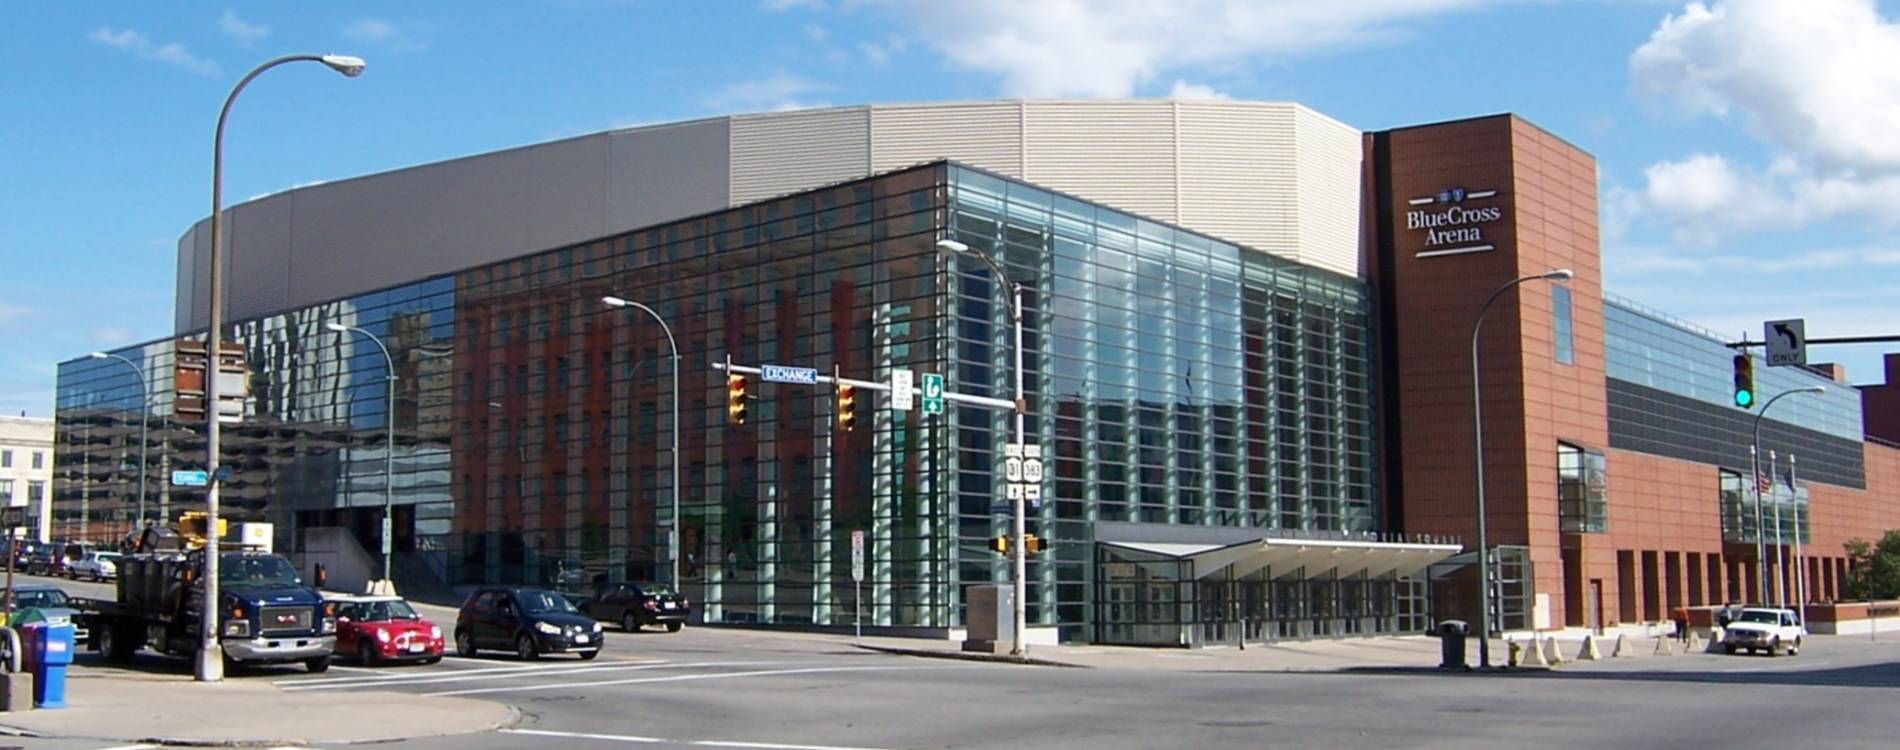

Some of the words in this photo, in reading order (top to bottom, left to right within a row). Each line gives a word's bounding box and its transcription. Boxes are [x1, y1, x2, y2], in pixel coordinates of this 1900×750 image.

[1407, 207, 1502, 229] BlueCross
[1425, 227, 1481, 246] Arena
[1773, 352, 1799, 362] ONLY
[766, 367, 812, 382] EXCHANGE
[1025, 464, 1040, 477] 383
